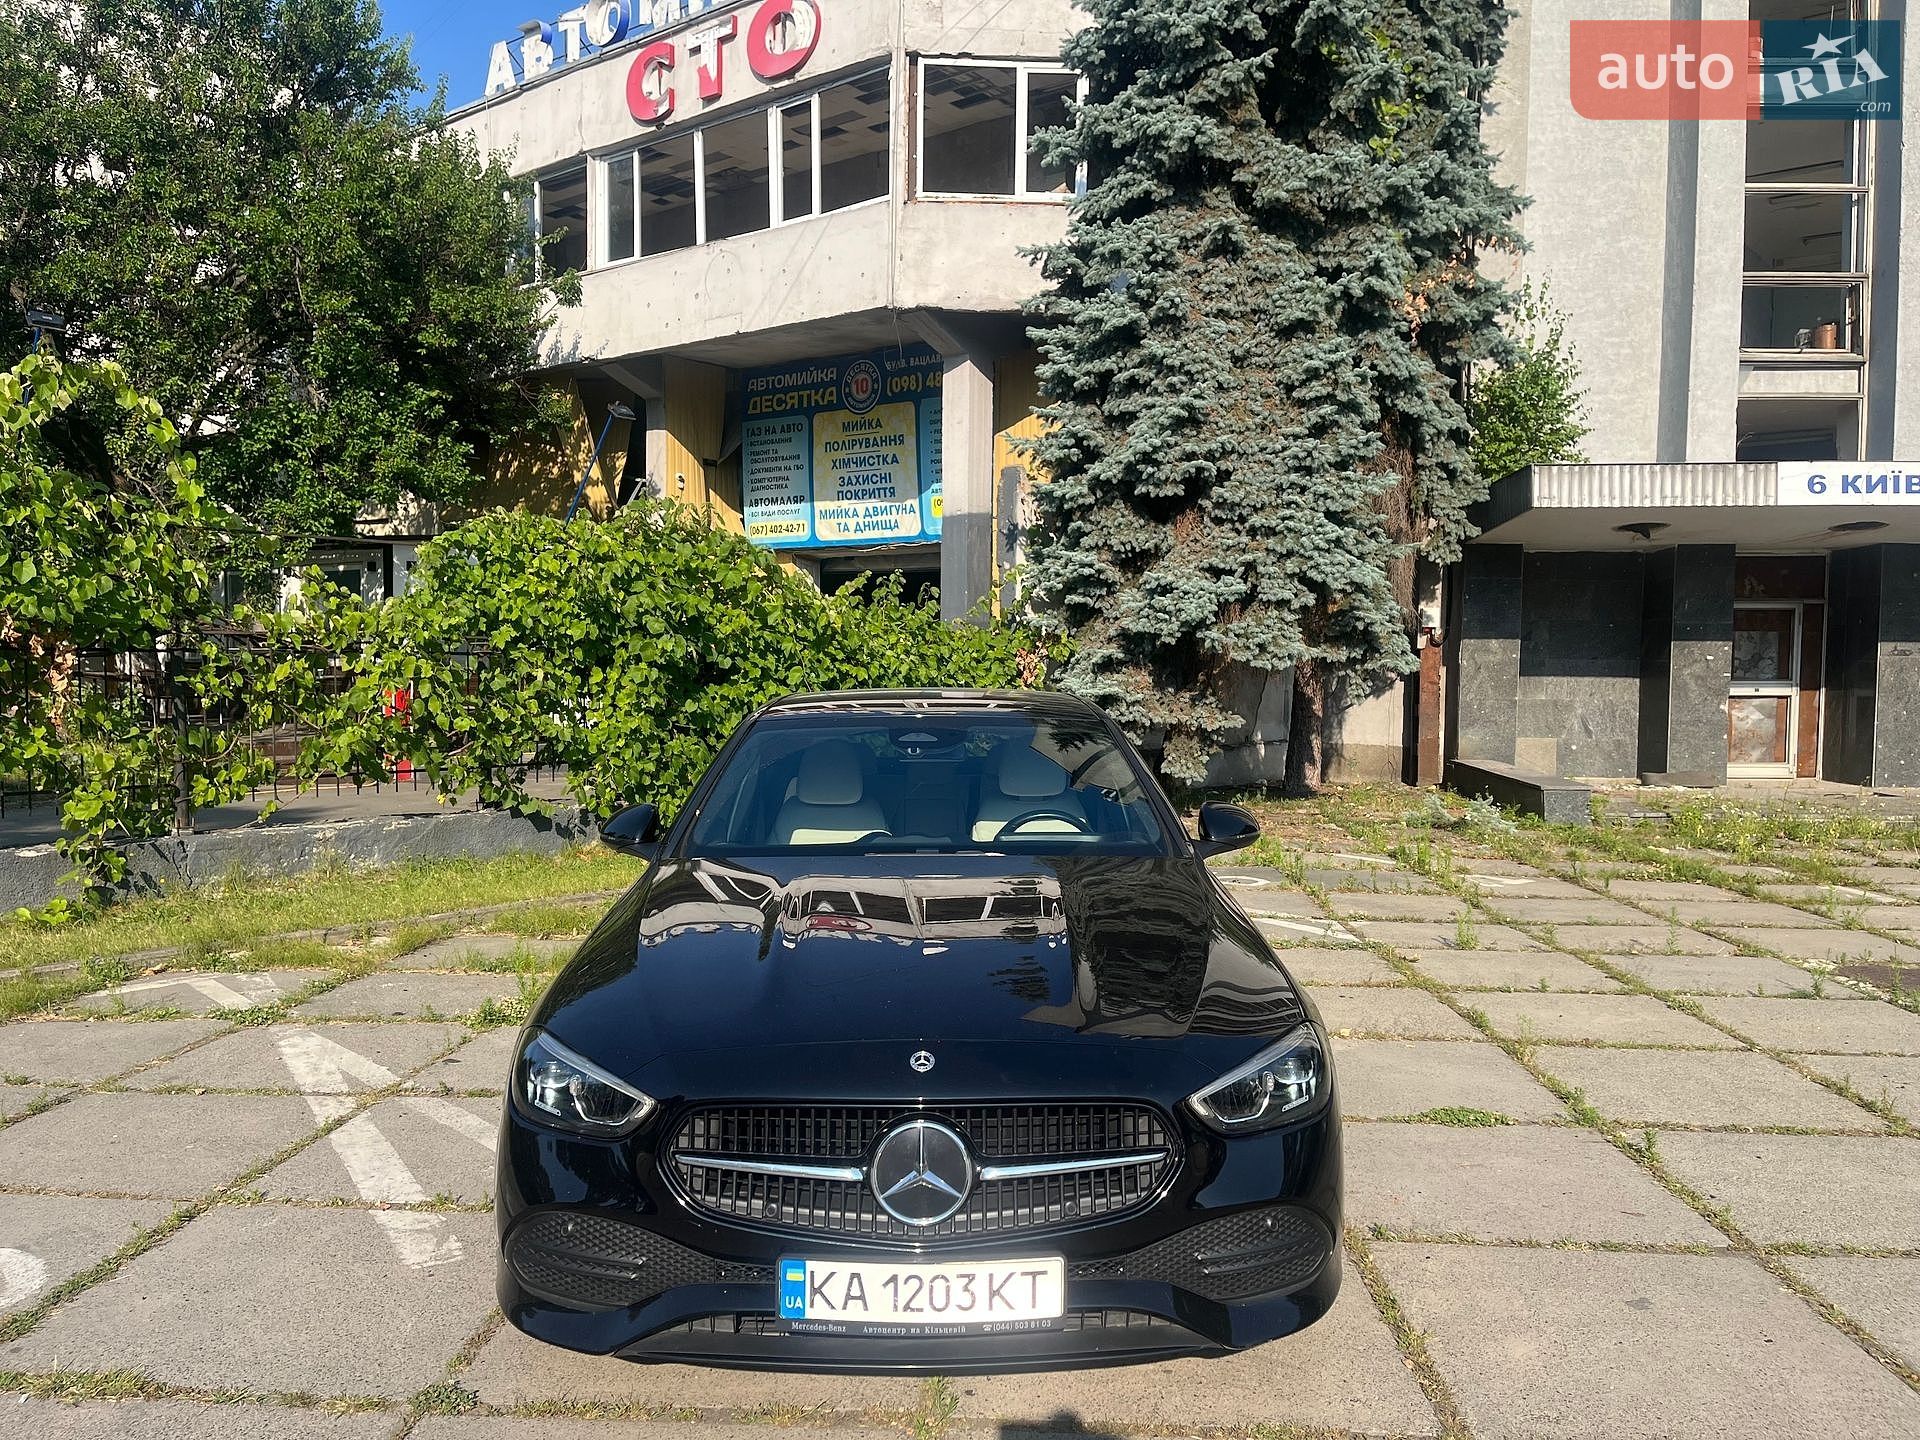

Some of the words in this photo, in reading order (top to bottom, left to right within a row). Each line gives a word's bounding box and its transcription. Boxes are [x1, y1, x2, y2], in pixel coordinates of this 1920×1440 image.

[626, 0, 821, 124] СТО
[747, 366, 837, 392] АВТОМИЙКА
[854, 378, 869, 395] 10
[887, 372, 922, 396] (098)
[747, 386, 837, 414] ДЕСЯТКА
[746, 427, 761, 438] ГАЗ
[764, 425, 777, 435] НА
[780, 423, 803, 434] АВТО
[842, 416, 883, 432] МИЙКА
[825, 434, 904, 453] ПОЛІРУВАННЯ
[831, 453, 899, 470] ХІМЧИСТКА
[750, 465, 782, 475] ДОКУМЕНТИ
[838, 472, 892, 487] ЗАХИСНІ
[1807, 474, 1827, 494] 6
[1841, 470, 1920, 494] КИЇВ
[749, 495, 805, 508] АВТОМАЛЯР
[837, 487, 896, 501] ПОКРИТТЯ
[819, 505, 859, 520] МИЙКА
[863, 504, 916, 519] ДВИГУНА
[750, 524, 768, 536] (067)
[769, 523, 805, 534] 402-42-71
[836, 522, 850, 533] ТА
[854, 519, 899, 534] ДНИЩА
[809, 1270, 869, 1311] KA
[882, 1274, 977, 1312] 1203
[988, 1271, 1048, 1311] KT
[785, 1296, 804, 1309] UA
[791, 1321, 847, 1333] Mercedes-Benz
[862, 1325, 906, 1335] Автоцентр
[924, 1325, 966, 1335] Кільцевій
[993, 1322, 1012, 1332] (044)
[1041, 1319, 1051, 1328] 03
